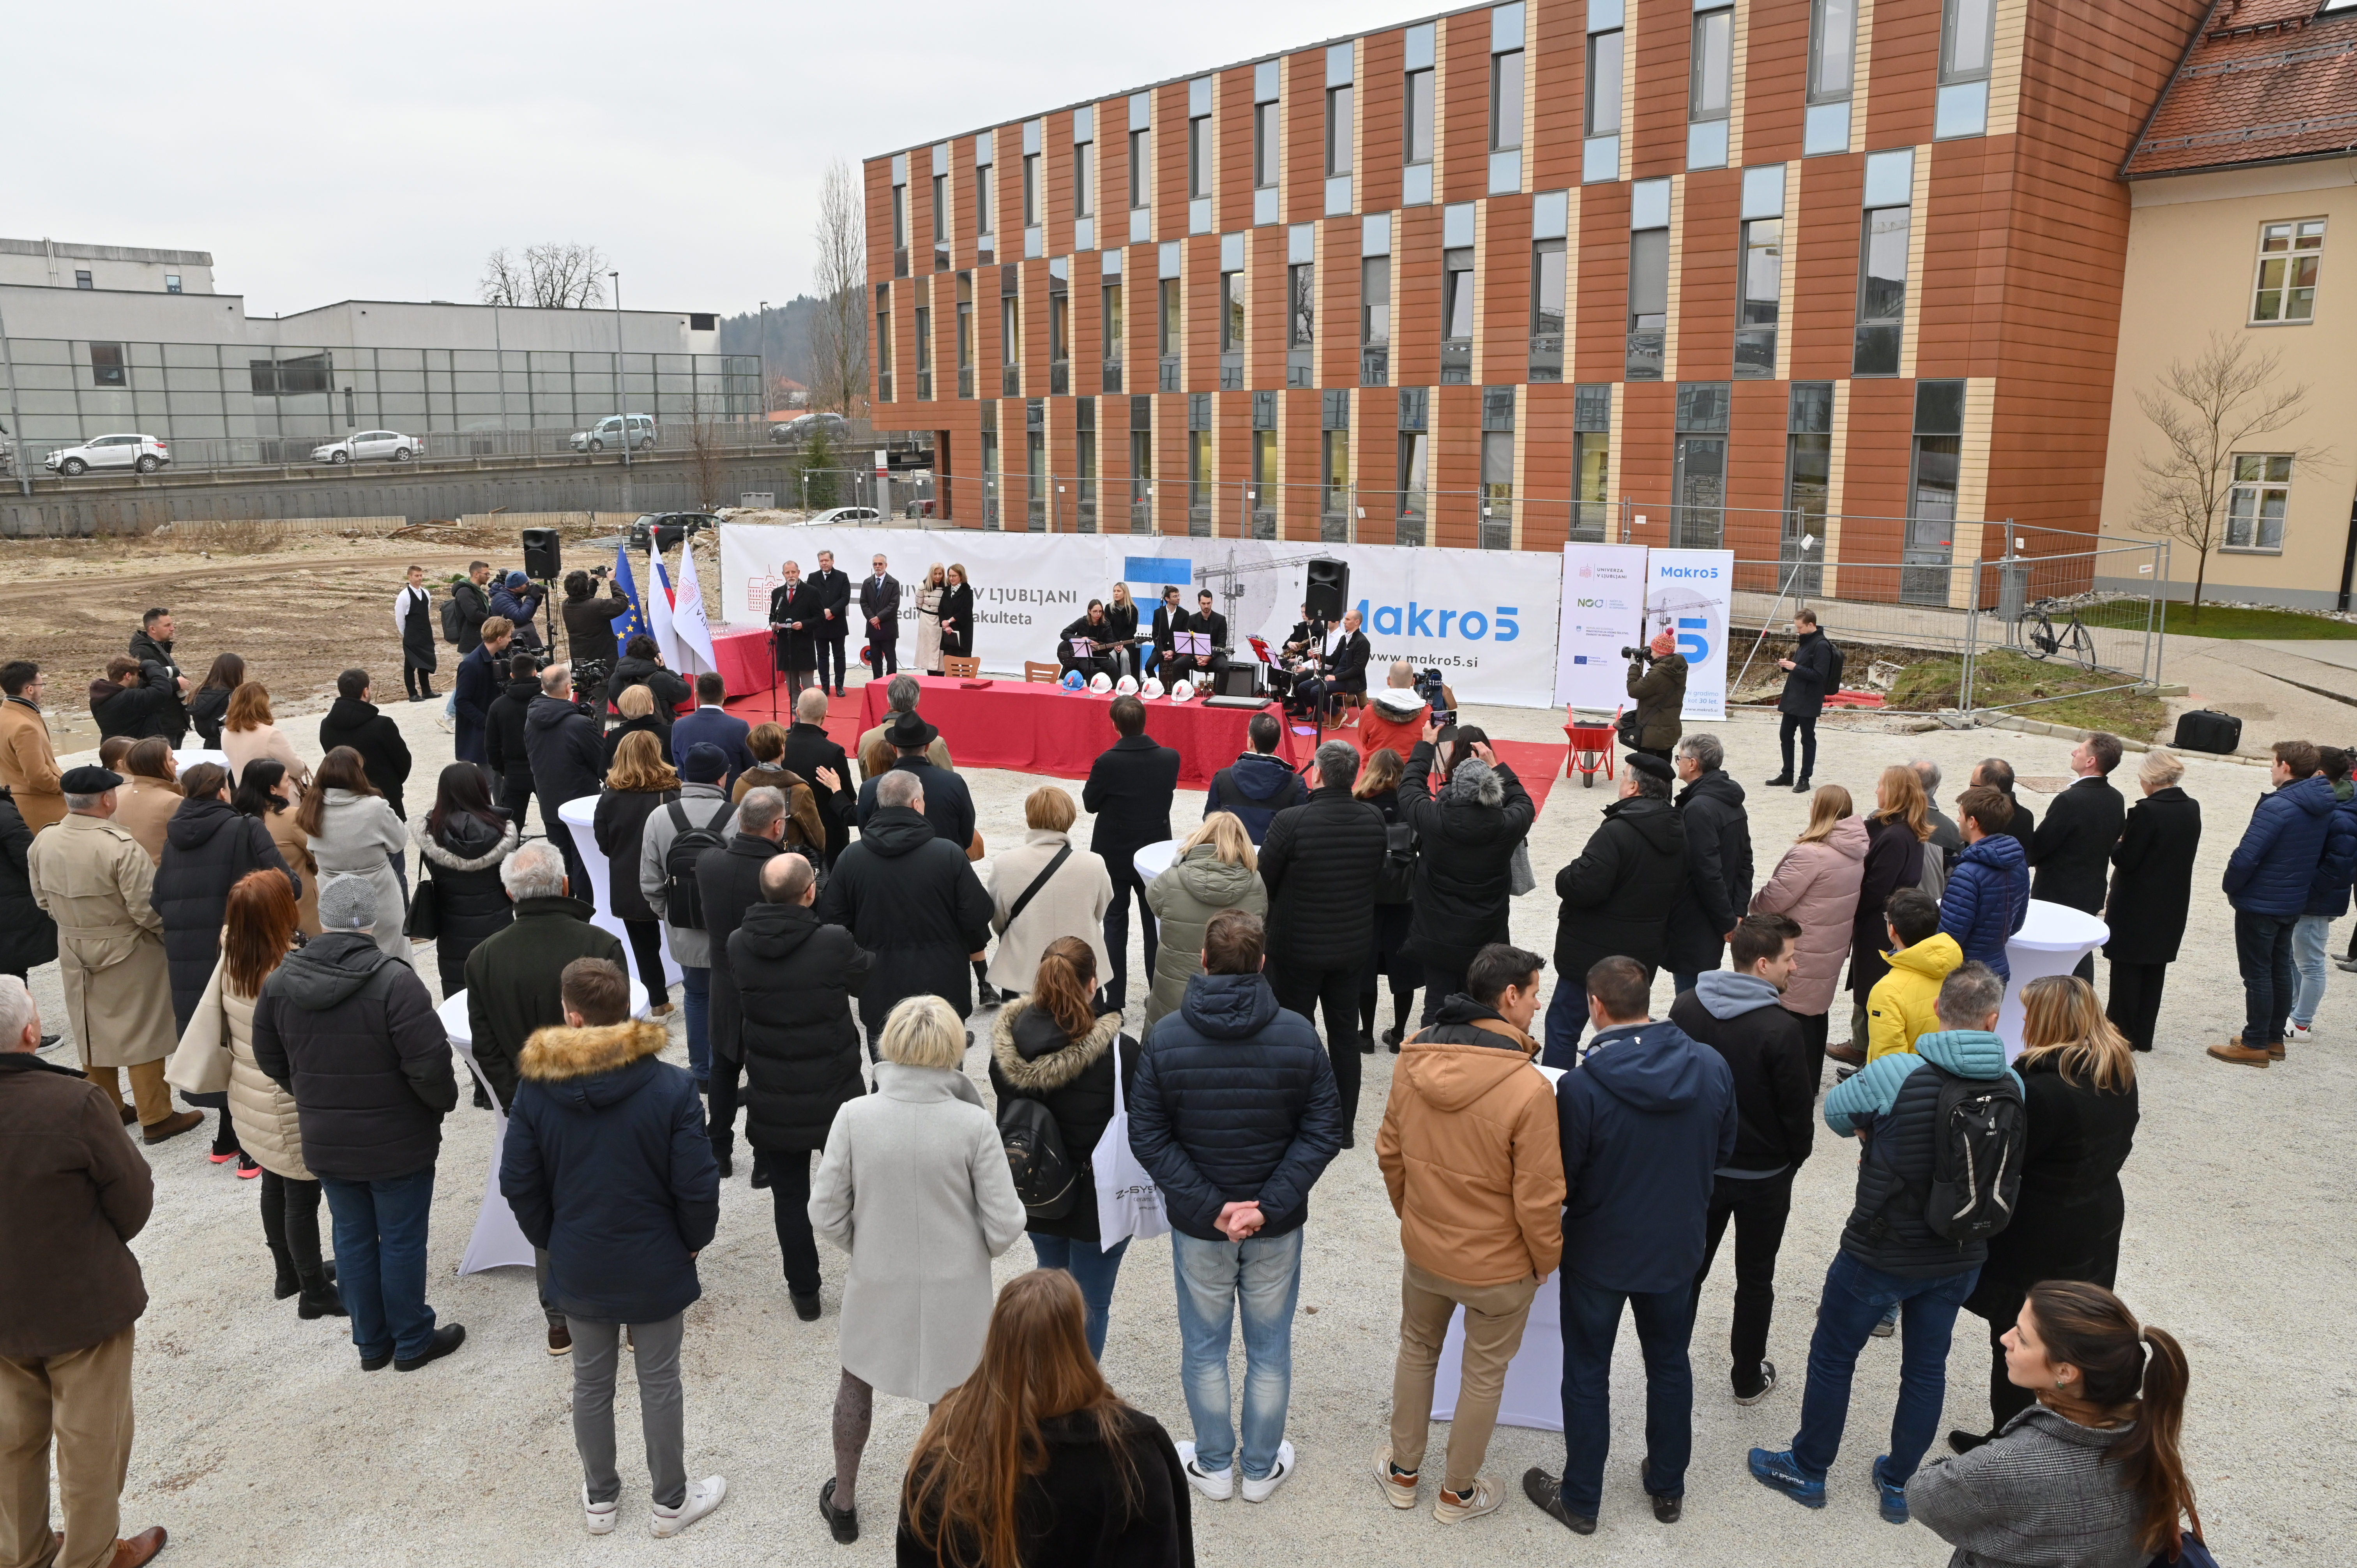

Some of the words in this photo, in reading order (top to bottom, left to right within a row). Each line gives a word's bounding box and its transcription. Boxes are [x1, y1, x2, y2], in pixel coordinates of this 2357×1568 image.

[1661, 567, 1718, 578] Makro5
[973, 587, 984, 600] V
[990, 588, 1077, 606] LJUBLJANI
[973, 610, 1032, 625] akulteta
[1779, 1473, 1804, 1485] SPORTIVA
